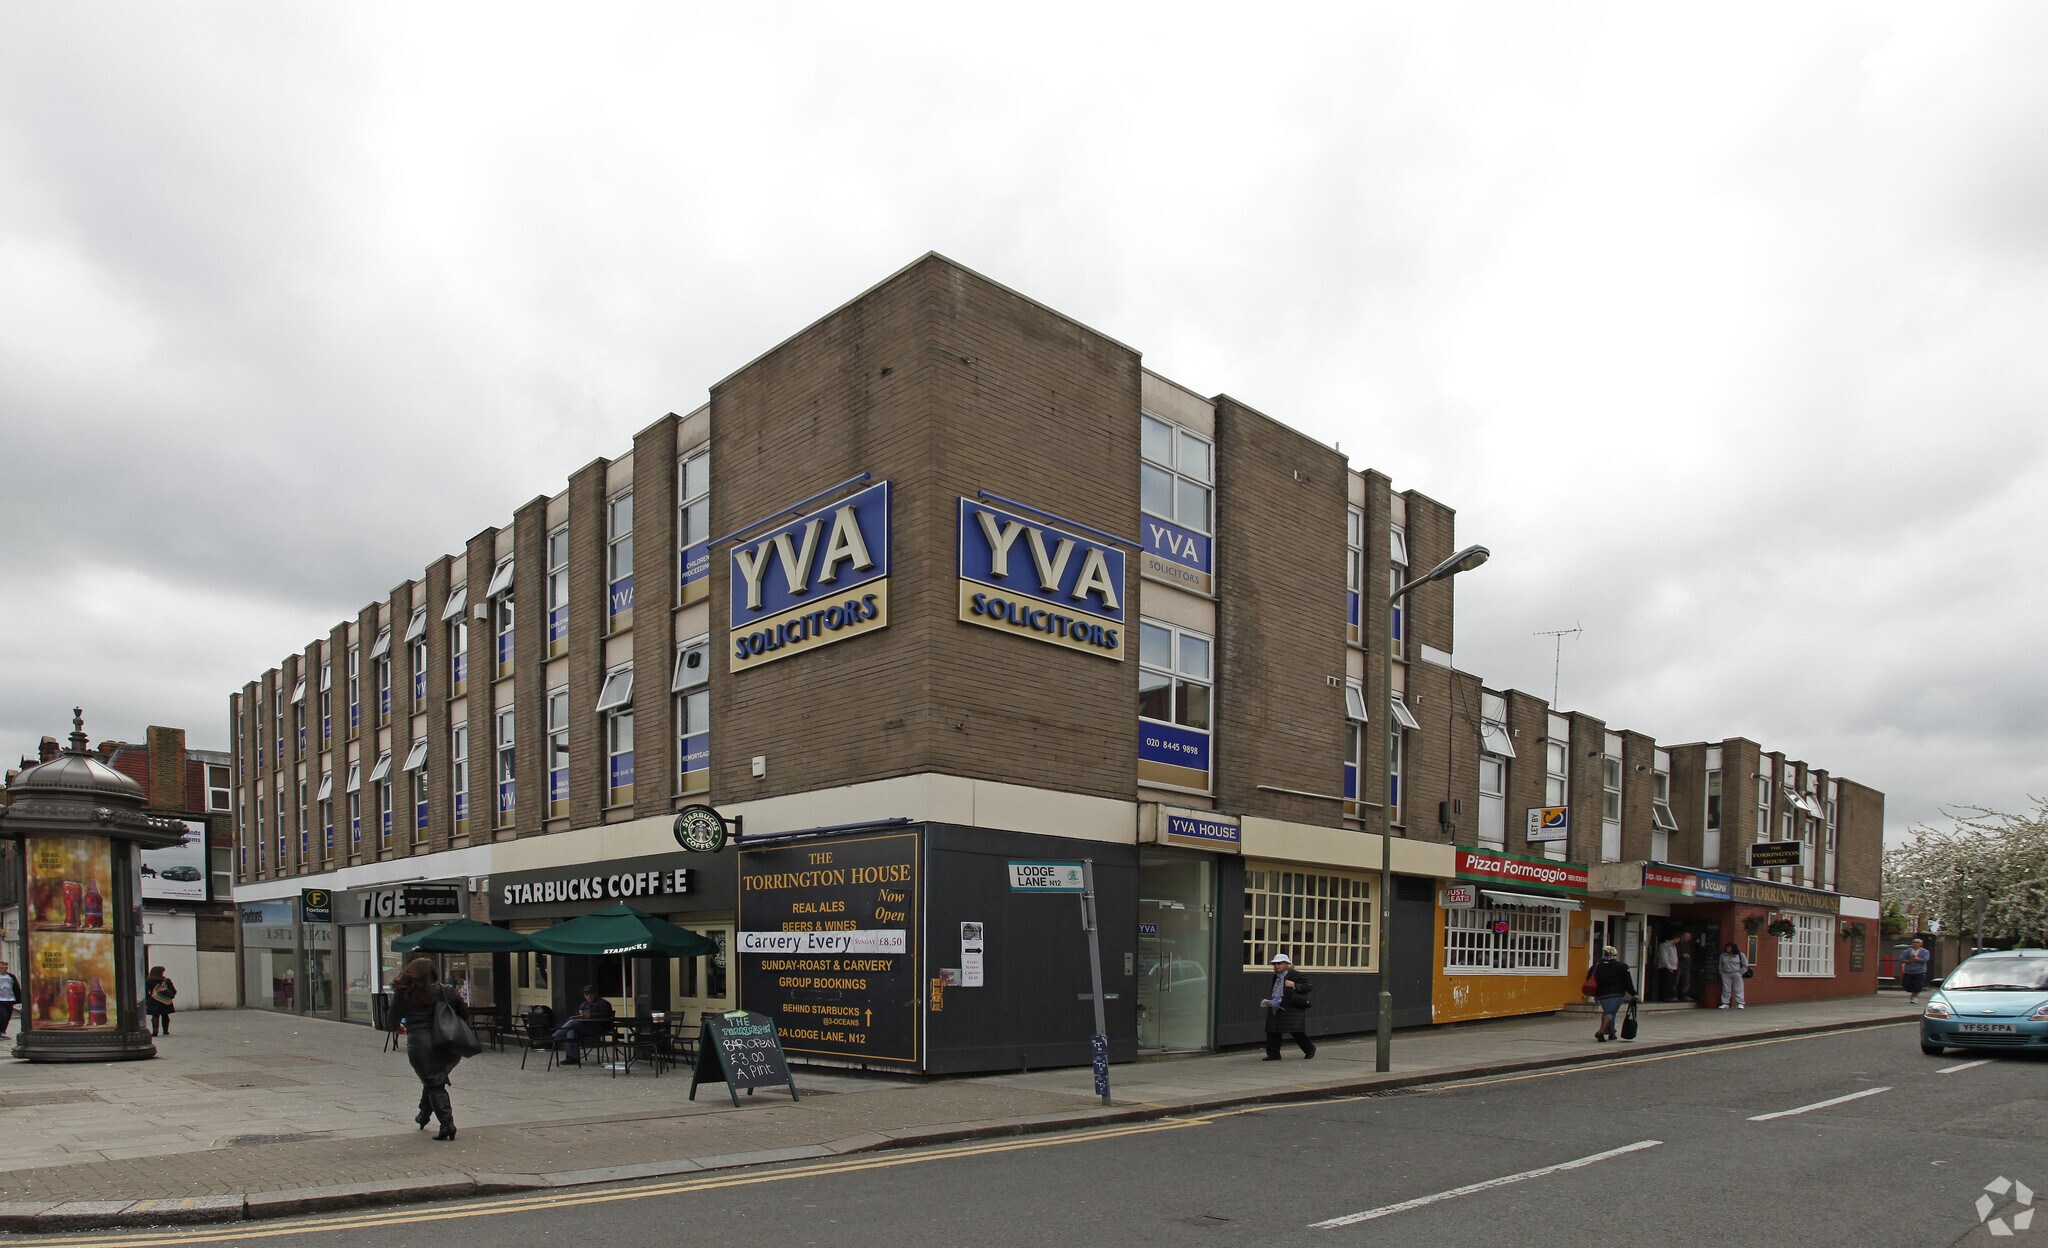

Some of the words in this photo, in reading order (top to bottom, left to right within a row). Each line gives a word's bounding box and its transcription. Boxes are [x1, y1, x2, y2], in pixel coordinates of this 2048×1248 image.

[1149, 523, 1199, 563] YVA
[734, 504, 873, 610] YVA
[976, 510, 1120, 610] YVA
[1148, 560, 1200, 584] SOLICITORS
[735, 594, 877, 659] SOLICITORS
[973, 592, 1119, 649] SOLICITORS
[1146, 737, 1160, 748] 020
[1163, 741, 1180, 752] 8445
[1182, 745, 1198, 755] 9898
[502, 792, 515, 807] YV
[682, 812, 719, 831] STARBUCKS
[1531, 814, 1538, 823] BY
[1172, 819, 1196, 834] YVA
[1199, 823, 1237, 839] HOUSE
[686, 837, 715, 849] COFFEE
[809, 852, 833, 865] THE
[1752, 850, 1799, 858] TORRINGTON
[1017, 867, 1055, 876] LODGE
[1466, 854, 1501, 872] Pizza
[1503, 860, 1567, 883] Formaggio
[743, 869, 845, 890] TORRINGTON
[851, 864, 911, 884] HOUSE
[1018, 877, 1047, 886] LANE
[504, 877, 603, 905] STARBUCKS
[1446, 888, 1466, 896] JUST
[1705, 879, 1727, 892] Oceans
[312, 893, 321, 905] F
[408, 897, 456, 906] TIGER
[877, 889, 905, 903] Now
[1733, 884, 1749, 898] THE
[1750, 884, 1812, 907] TORRINGTON
[1813, 894, 1839, 910] HOUSE
[357, 889, 407, 918] TIGE
[792, 902, 817, 914] REAL
[819, 900, 845, 912] ALES
[242, 908, 263, 924] Foxtons
[875, 906, 905, 923] Open
[782, 921, 813, 932] BEERS
[815, 921, 822, 931] &
[825, 920, 857, 931] WINES
[1139, 925, 1156, 933] YVA
[745, 933, 801, 953] Carvery
[808, 933, 851, 952] Every
[879, 937, 902, 946] £8.50
[761, 959, 831, 971] SUNDAY-ROAST
[833, 960, 841, 971] &
[843, 960, 893, 971] CARVERY
[779, 977, 812, 988] GROUP
[813, 977, 867, 990] BOOKINGS
[783, 1003, 810, 1013] BEHIND
[812, 1005, 860, 1017] STARBUCKS
[727, 1017, 749, 1027] THE
[823, 1017, 859, 1026] @3-OCEANS
[1963, 1024, 1990, 1032] YF55
[1992, 1024, 2012, 1032] FPA
[778, 1028, 788, 1038] 2A
[790, 1028, 818, 1040] LODGE
[821, 1031, 847, 1044] LANE,
[848, 1033, 866, 1044] N12
[723, 1039, 747, 1052] BAR
[736, 1068, 749, 1080] A
